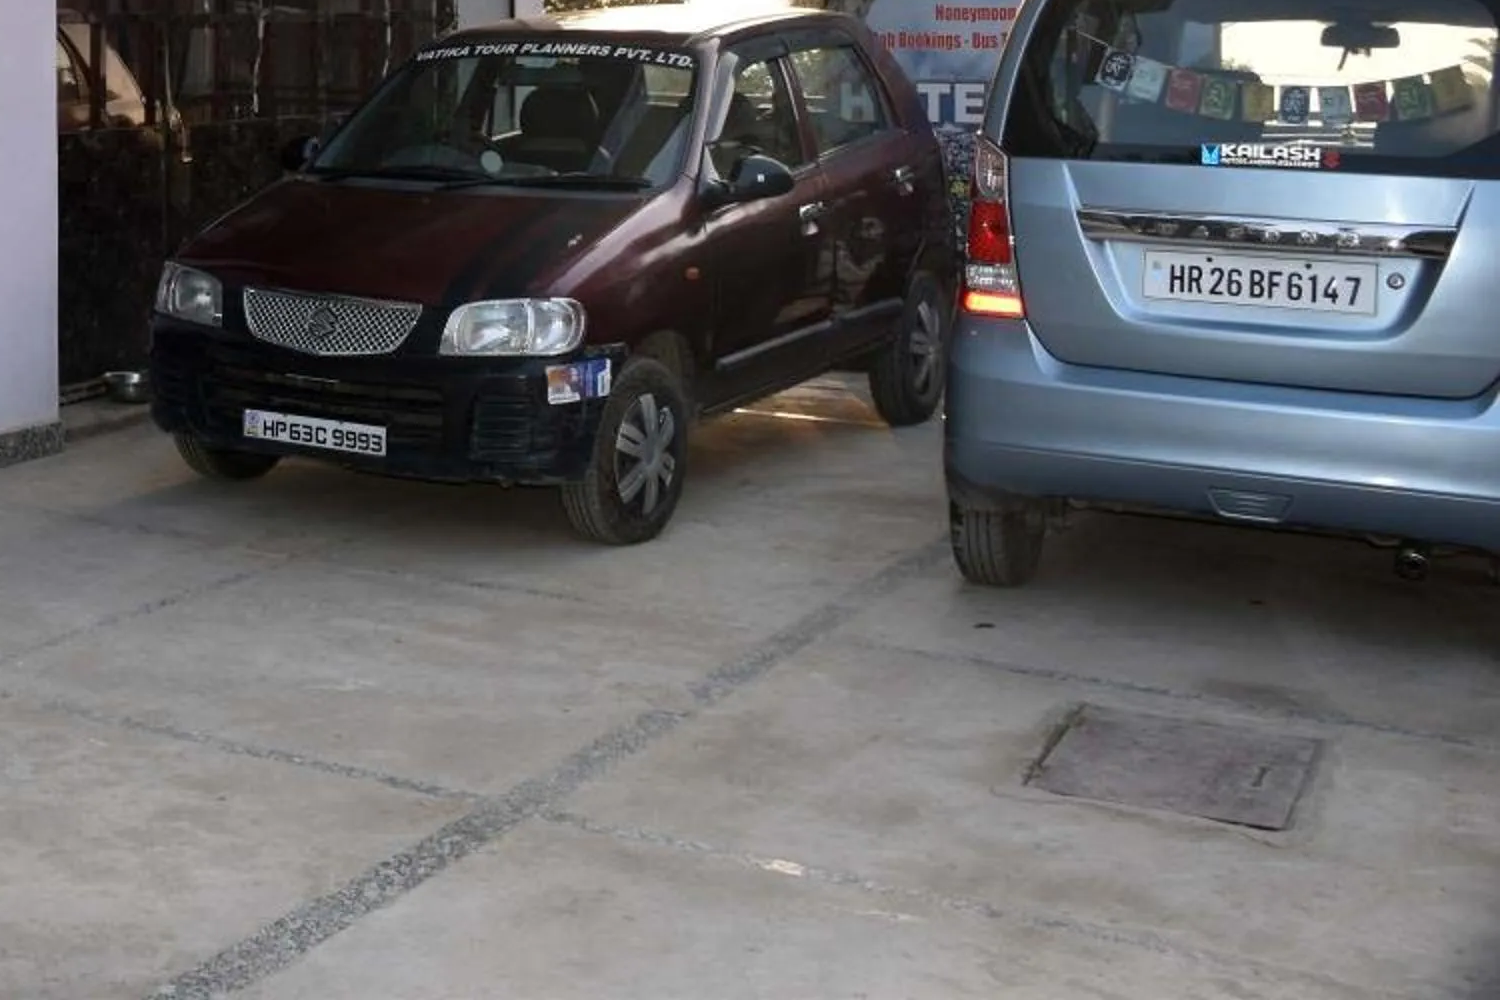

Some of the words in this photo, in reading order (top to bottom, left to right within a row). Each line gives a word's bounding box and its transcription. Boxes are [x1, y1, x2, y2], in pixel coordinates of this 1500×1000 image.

[899, 32, 961, 50] Bookings
[474, 43, 518, 56] TOUR
[520, 42, 610, 58] PLANNERS
[614, 46, 650, 61] PVT.
[655, 51, 694, 68] LTD.
[1221, 142, 1322, 161] KAILASH
